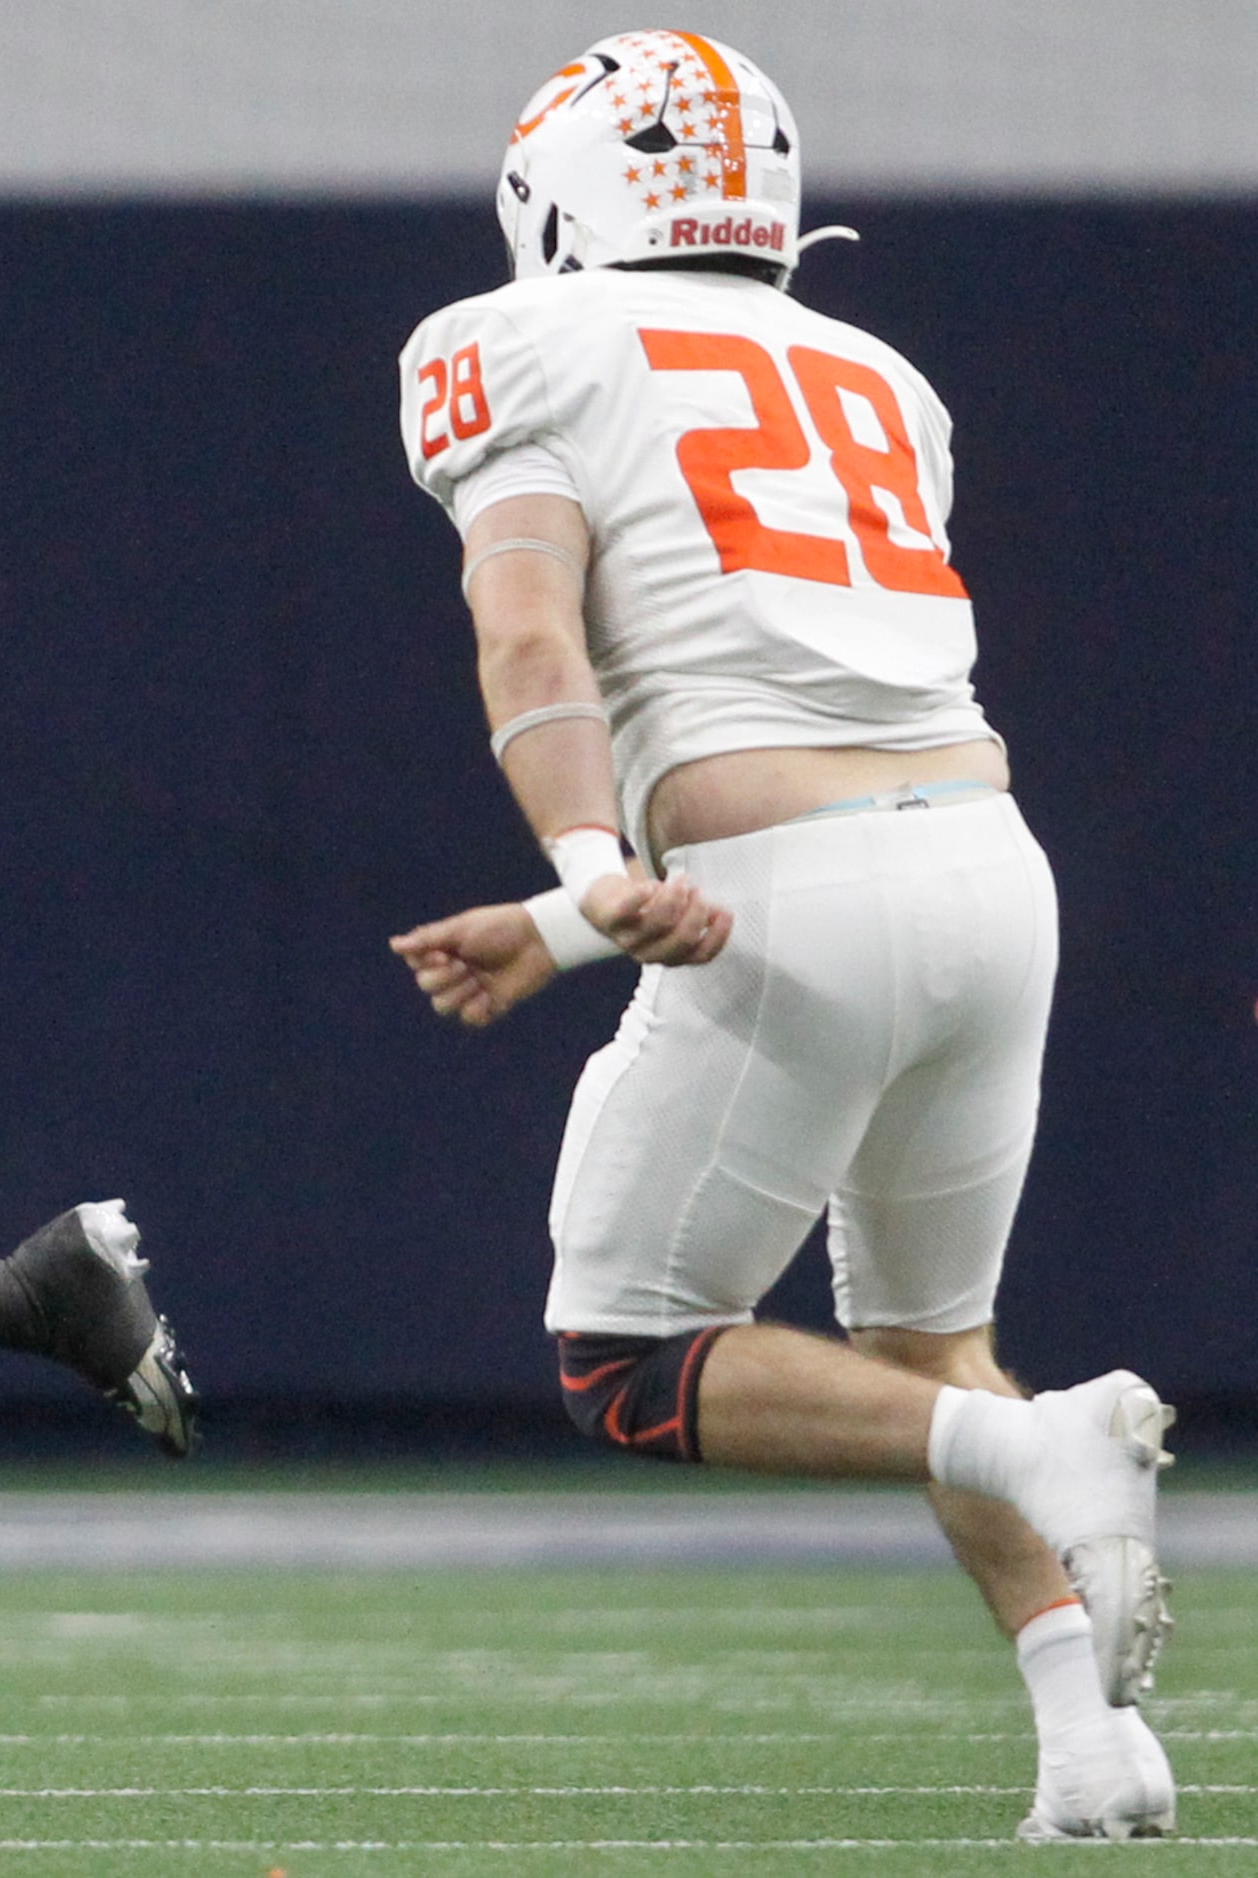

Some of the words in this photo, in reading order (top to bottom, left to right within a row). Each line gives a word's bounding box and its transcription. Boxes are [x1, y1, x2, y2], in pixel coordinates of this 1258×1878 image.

[670, 217, 785, 251] Riddell
[418, 341, 491, 460] 28
[637, 327, 970, 600] 28
